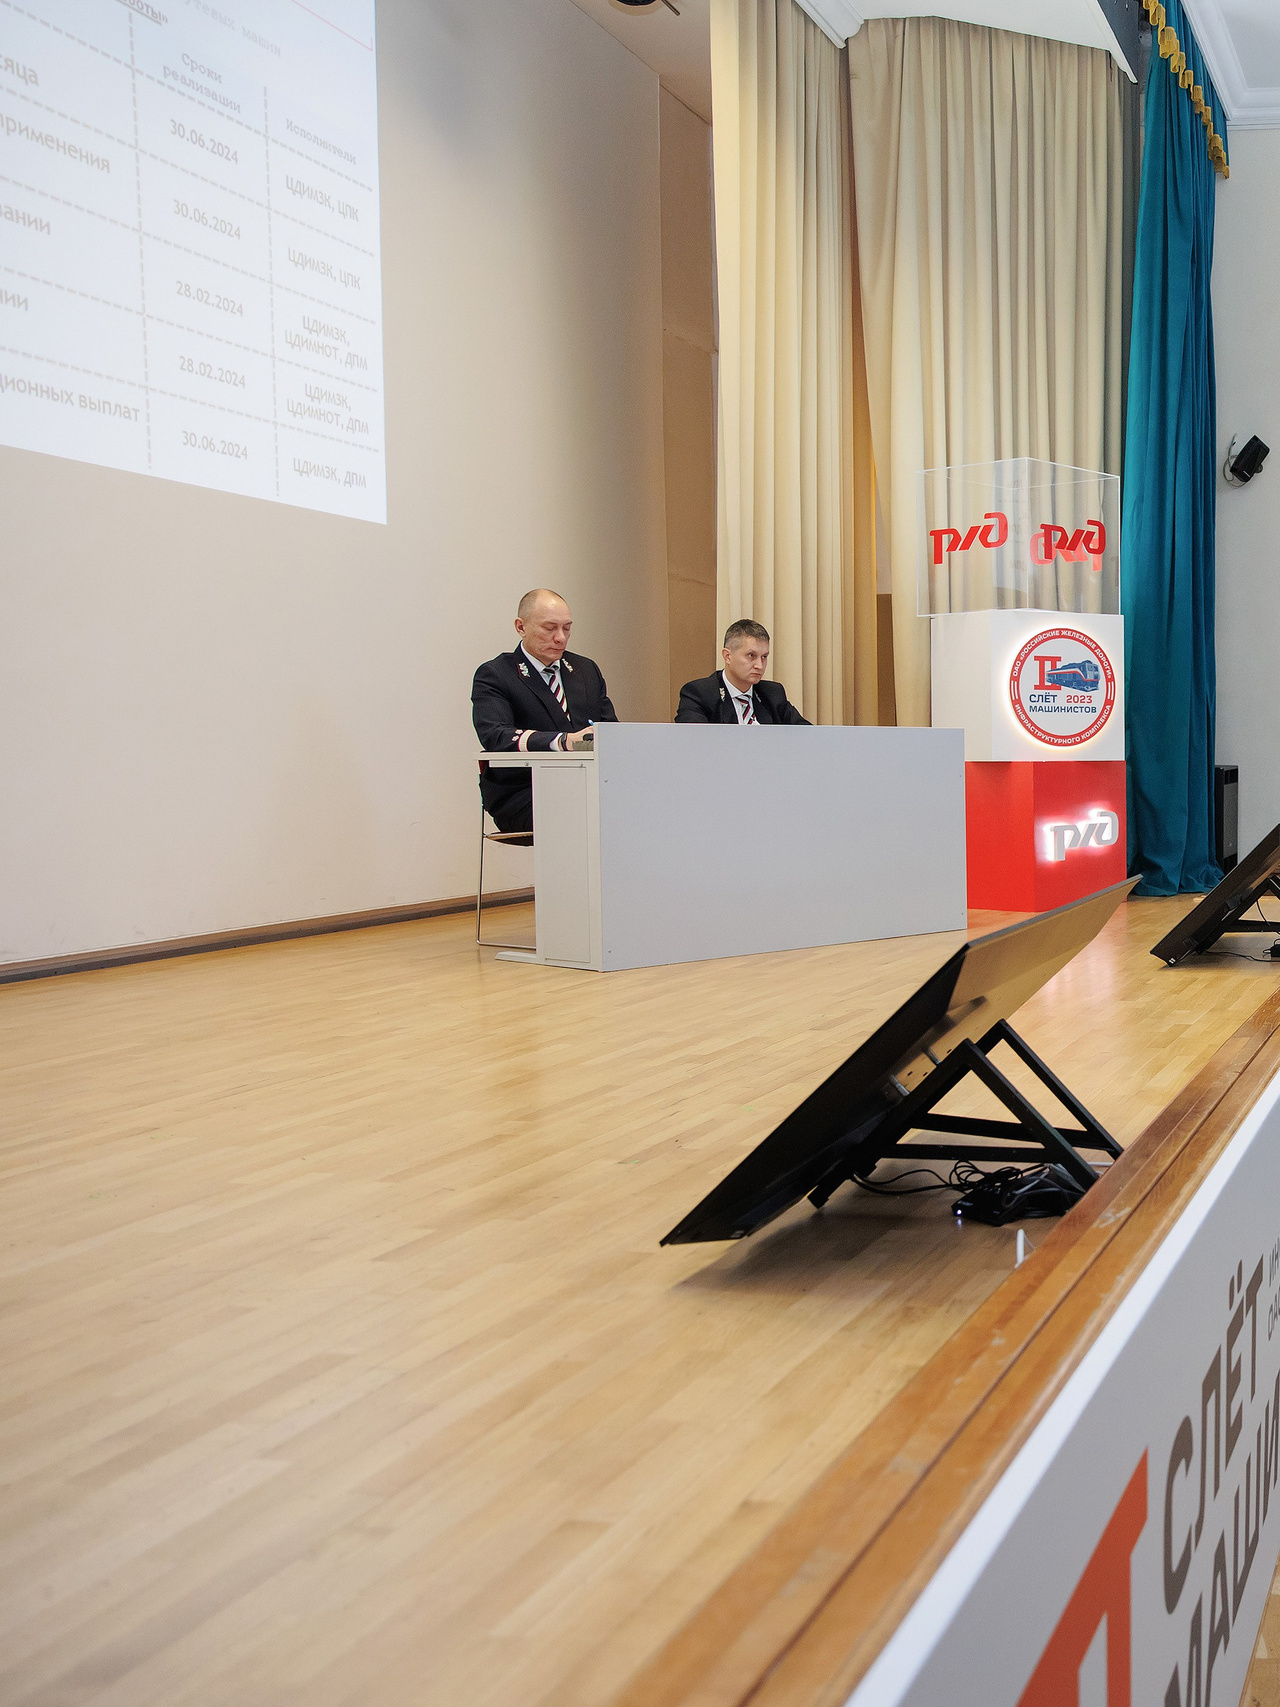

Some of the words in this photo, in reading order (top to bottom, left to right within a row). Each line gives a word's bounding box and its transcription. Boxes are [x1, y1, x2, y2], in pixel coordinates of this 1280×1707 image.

[242, 27, 281, 57] машин
[182, 53, 222, 84] Сроки
[163, 65, 241, 113] реализации
[169, 118, 239, 165] 30.06.2024
[286, 118, 356, 165] Исполнители
[173, 199, 241, 240] 30.06.2024
[337, 200, 359, 222] ЦПК
[340, 269, 360, 290] ЦПК
[176, 280, 244, 317] 28.02.2024
[179, 355, 246, 388] 28.02.2024
[345, 352, 368, 371] ДПМ
[78, 394, 140, 422] выплат
[346, 417, 369, 435] ДПМ
[182, 430, 248, 460] 30.06.2024
[344, 470, 367, 489] ДПМ
[1013, 660, 1021, 677] ОАО
[1061, 630, 1096, 649] ЖЕЛЕЗНЫЕ
[1095, 648, 1112, 679] ДОРОГИ»
[1029, 692, 1058, 703] СЛЁТ
[1066, 695, 1093, 704] 2023
[1029, 705, 1097, 714] МАШИНИСТОВ
[1015, 703, 1080, 744] ИНФРАСТРУКТУРНОГО
[1081, 704, 1111, 739] КОМПЛЕКСА
[1163, 1253, 1263, 1615] СЛЁТ
